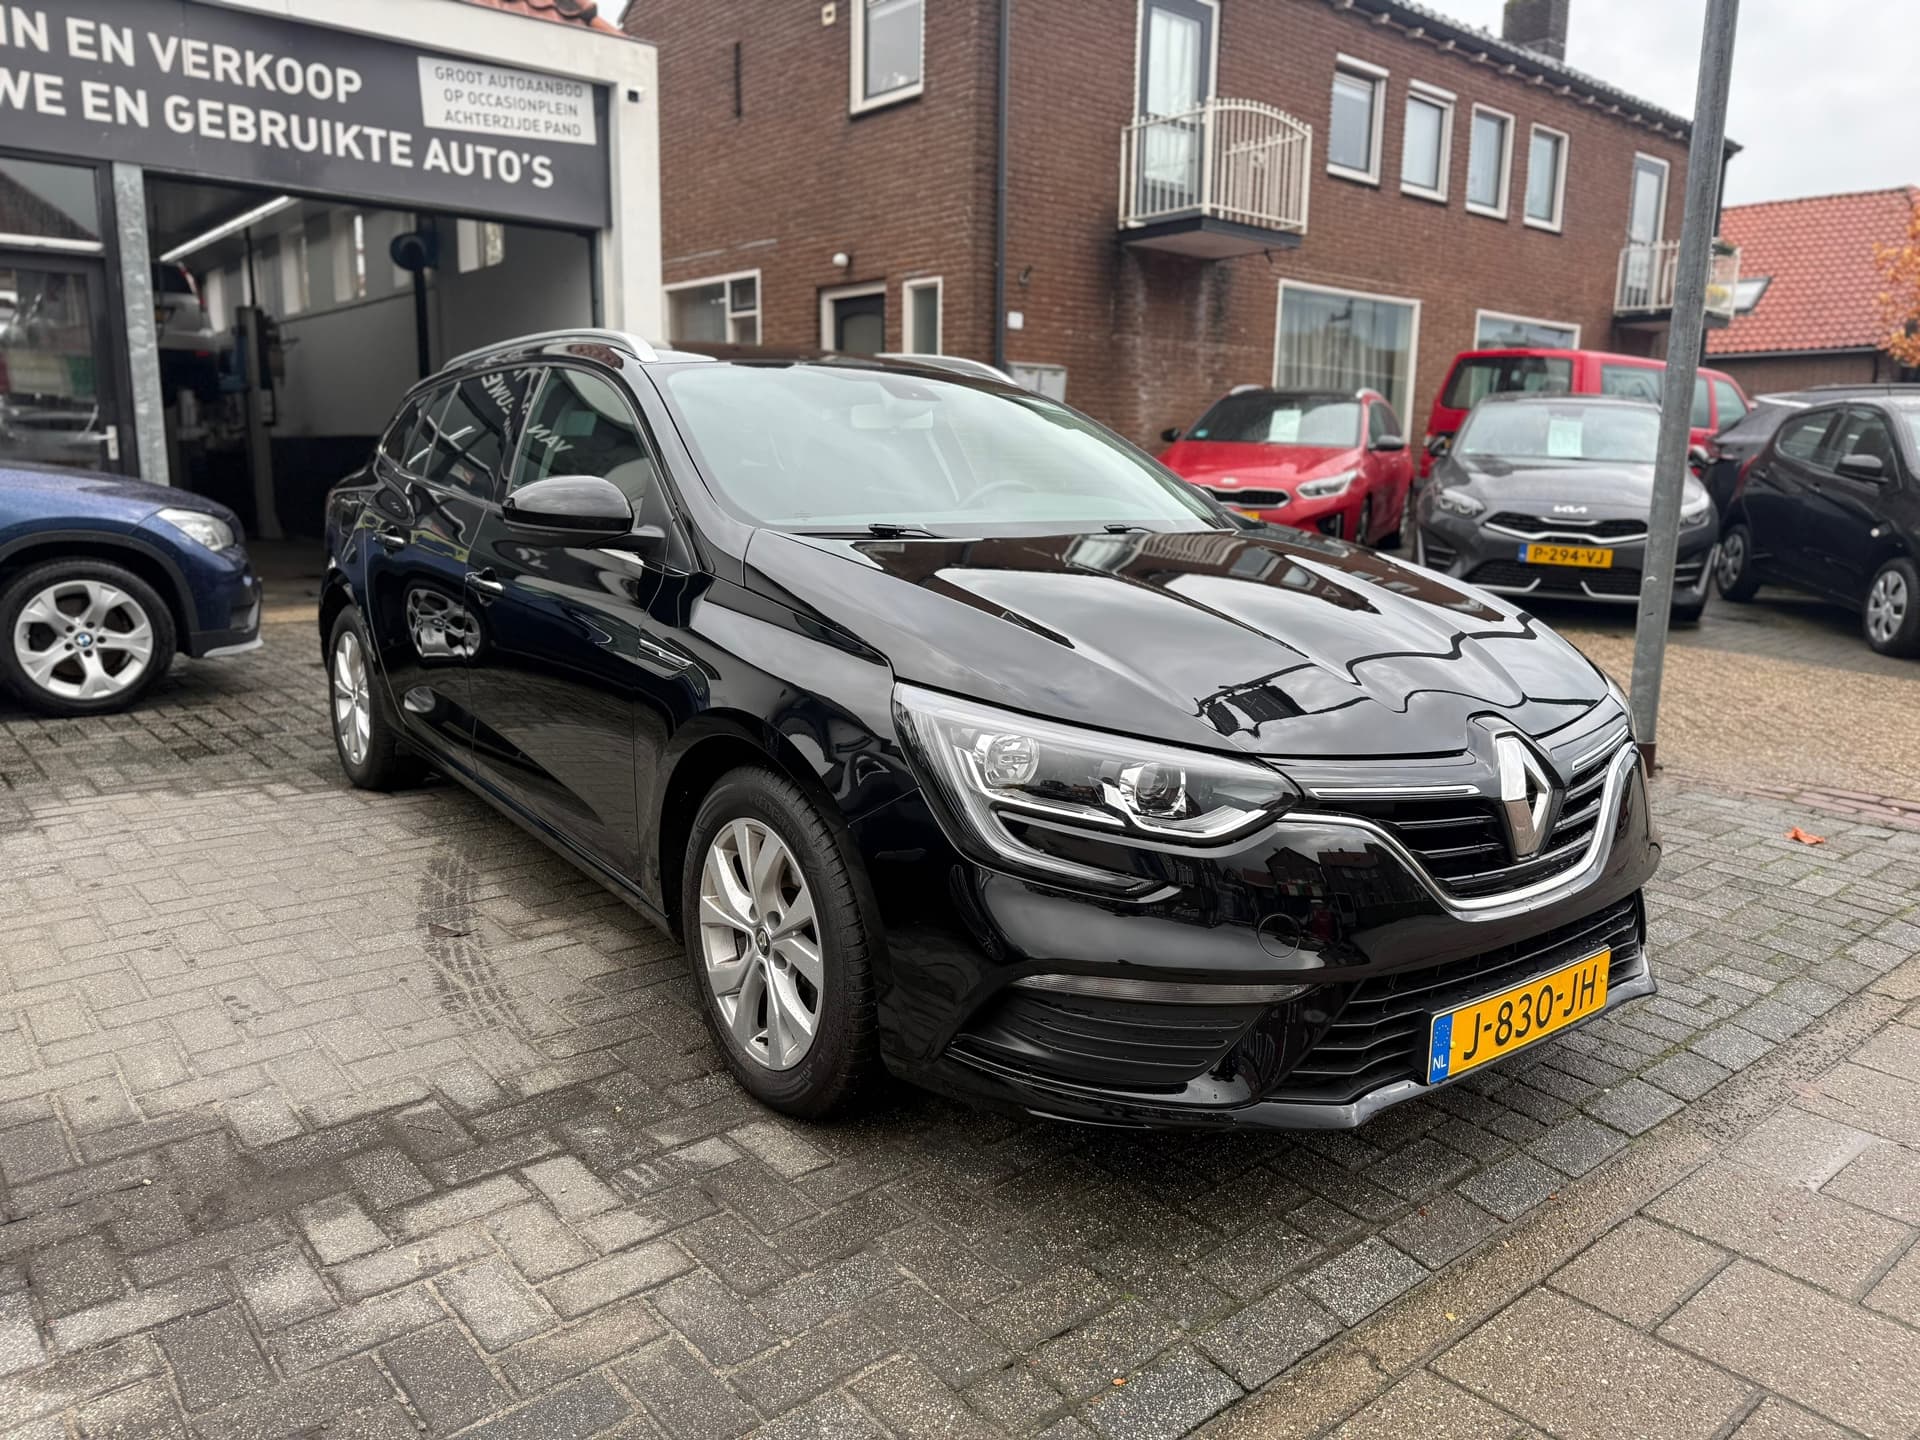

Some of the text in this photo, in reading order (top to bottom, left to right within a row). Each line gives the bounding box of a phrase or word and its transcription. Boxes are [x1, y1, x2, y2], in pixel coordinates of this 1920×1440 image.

[65, 16, 135, 67] EN
[147, 31, 362, 104] VERKOOP
[435, 66, 583, 98] GROOT AUTOAANBOD
[444, 88, 578, 117] OP OCCASIONPLEIN
[81, 80, 149, 128] EN
[164, 94, 414, 168] GEBRUIKTE
[423, 137, 554, 188] AUTO'S
[444, 110, 582, 137] ACHTERZIJDE PAND
[1533, 547, 1605, 564] P-294-VJ
[1463, 964, 1598, 1060] J-830-JH
[1432, 1054, 1446, 1072] NL
